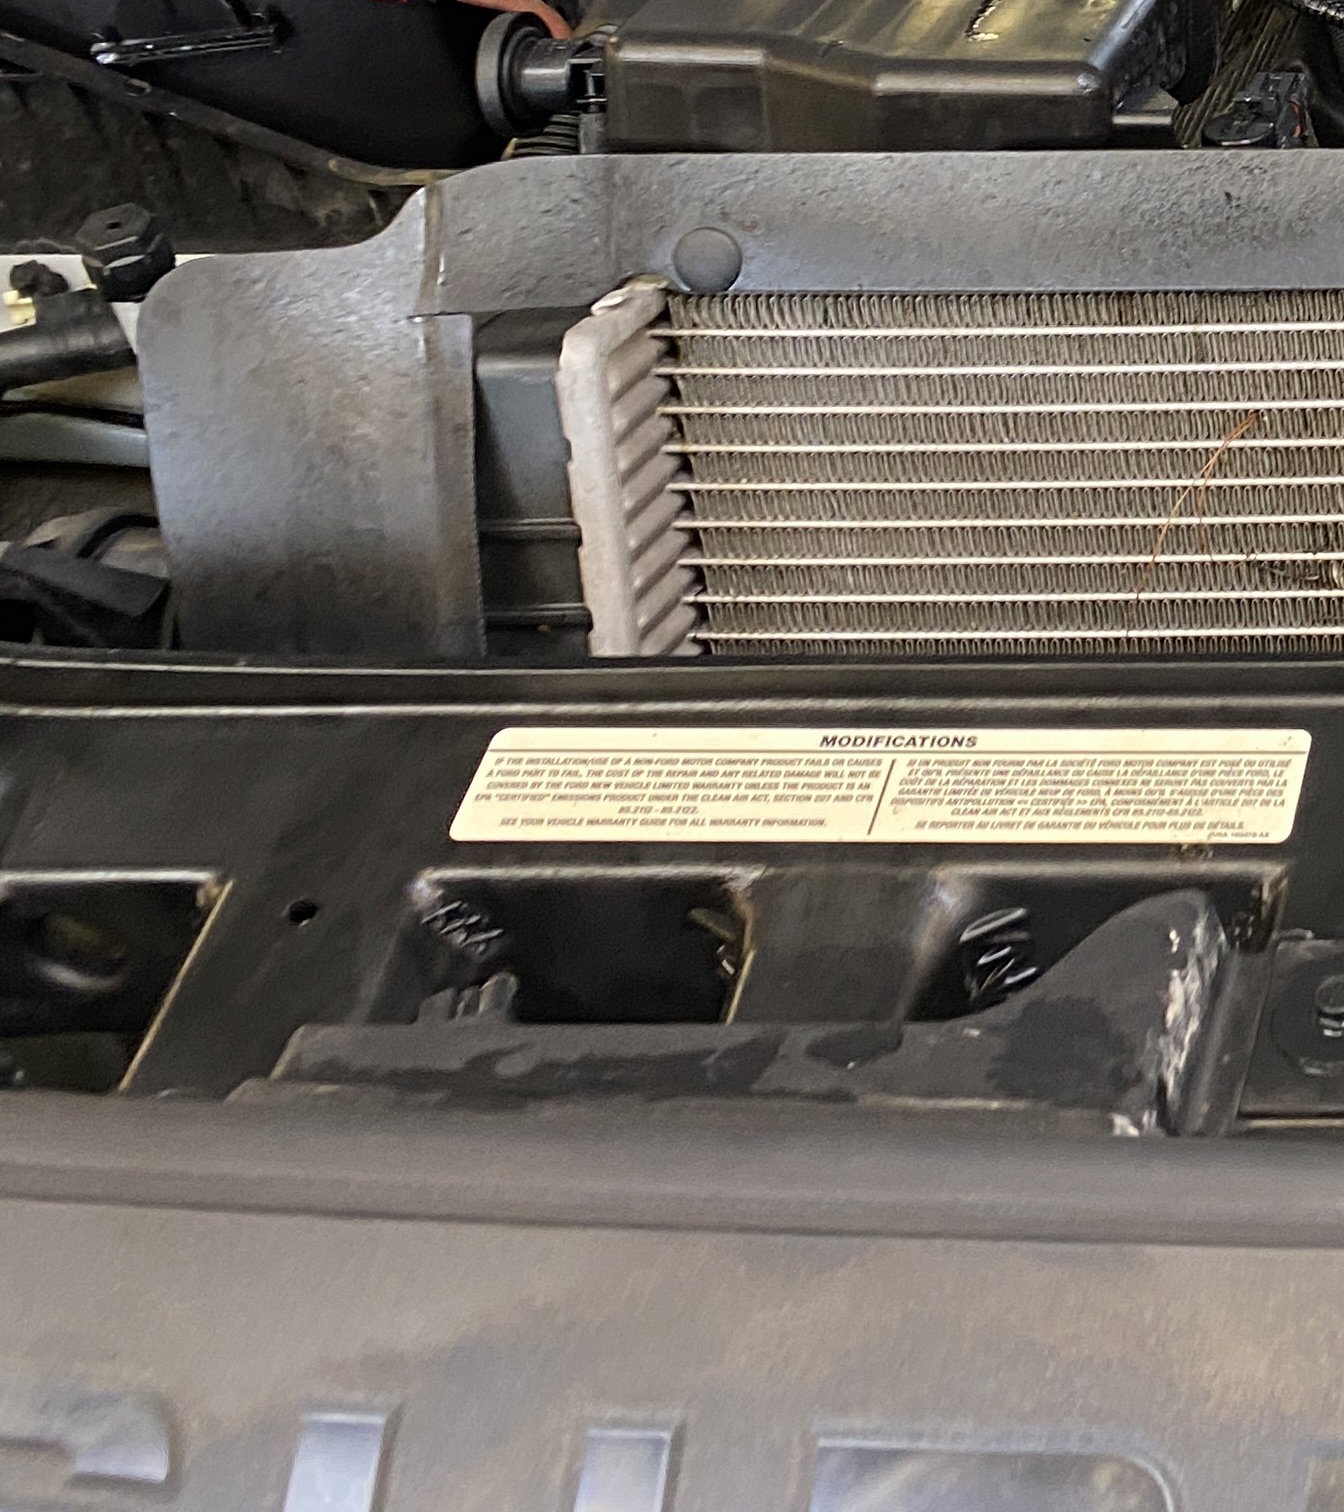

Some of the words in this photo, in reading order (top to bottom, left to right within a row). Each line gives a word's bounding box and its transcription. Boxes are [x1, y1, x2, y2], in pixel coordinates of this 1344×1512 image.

[819, 735, 978, 748] MODIFICATIONS
[505, 757, 524, 767] THE
[679, 757, 714, 767] MOTOR
[713, 757, 759, 767] COMPANY
[494, 769, 520, 778] FORD
[699, 769, 719, 779] AND
[562, 781, 589, 790] FORD
[612, 781, 651, 790] VEHICLE
[690, 781, 742, 791] WARRANTY
[781, 781, 800, 791] THE
[680, 793, 699, 803] THE
[832, 793, 854, 803] AND
[545, 817, 584, 827] VEHICLE
[585, 817, 637, 827] WARRANTY
[708, 818, 760, 827] WARRANTY
